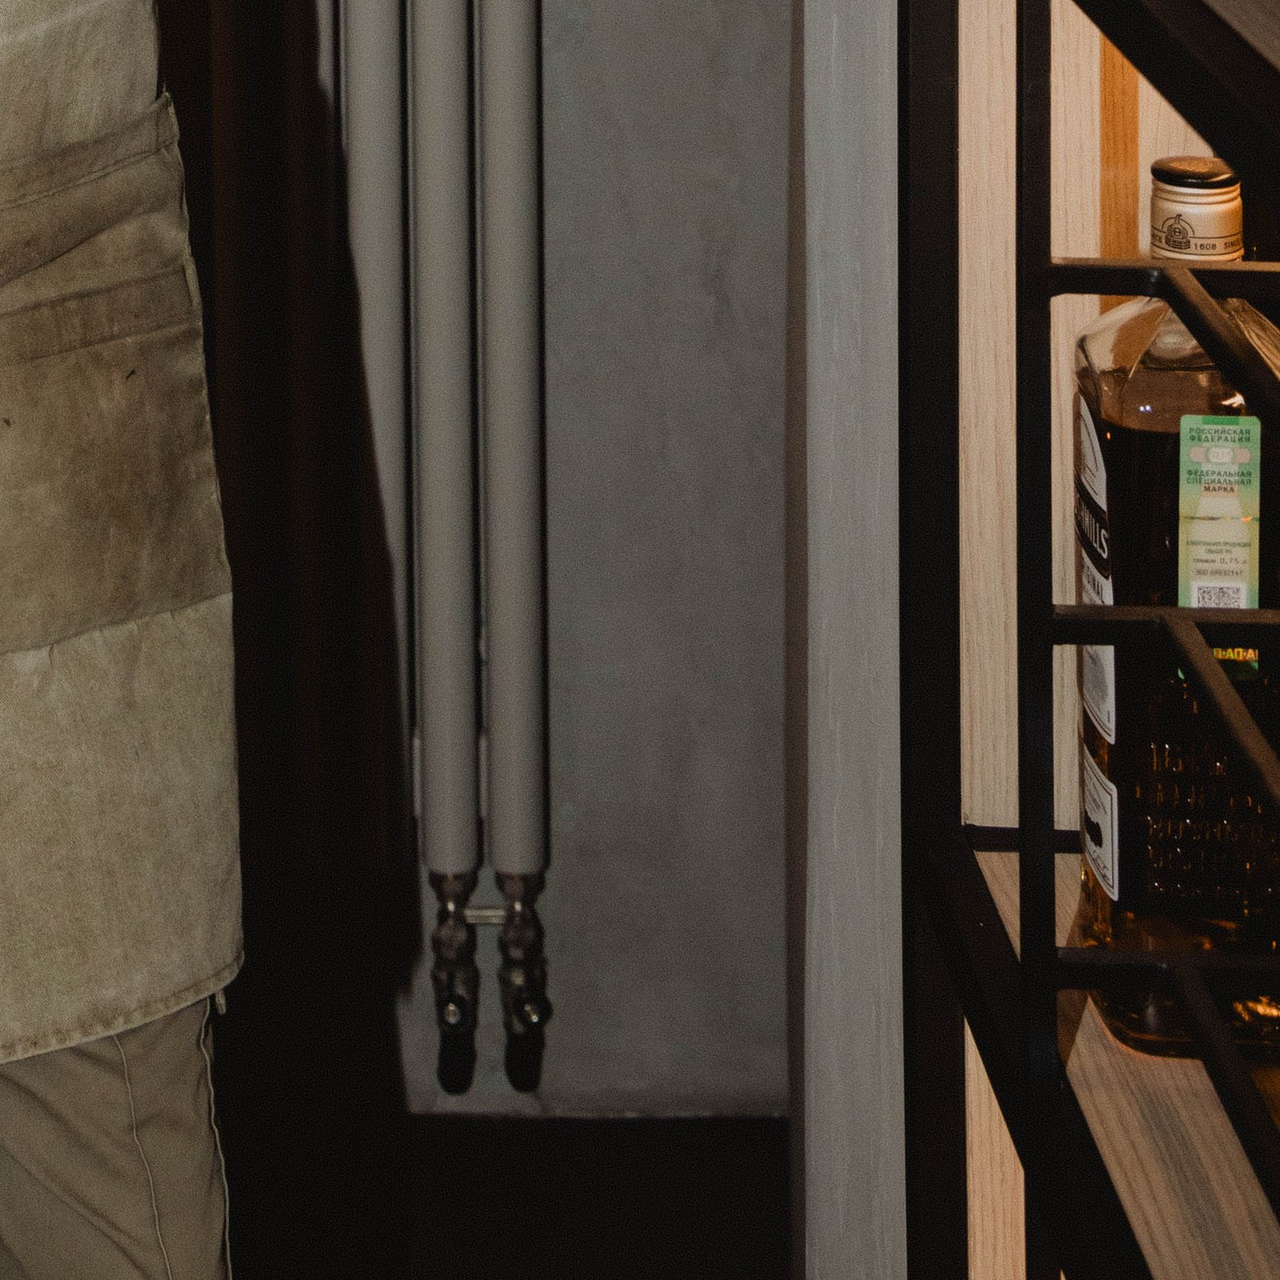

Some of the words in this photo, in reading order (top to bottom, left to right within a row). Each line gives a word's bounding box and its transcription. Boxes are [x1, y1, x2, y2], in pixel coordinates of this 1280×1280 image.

[1194, 243, 1217, 251] 1608
[1189, 427, 1251, 436] РОССИЙСКАЯ
[1189, 435, 1251, 443] ФЕДЕРАЦИЯ
[1186, 469, 1252, 478] ФЕДЕРАЛЬНАЯ
[1186, 477, 1252, 486] СПЕЦИАЛЬНАЯ
[1203, 485, 1235, 494] МАРКА
